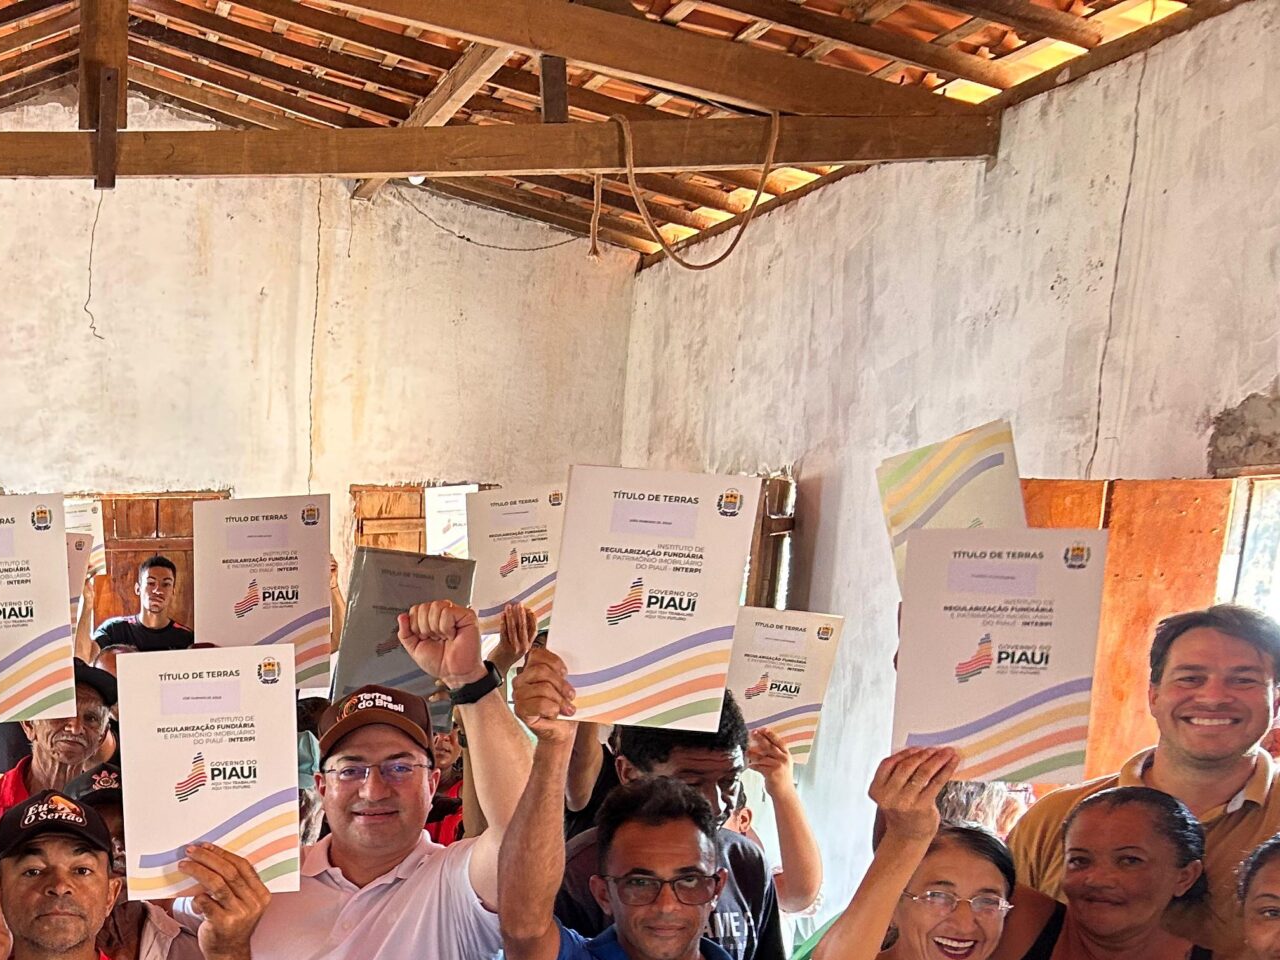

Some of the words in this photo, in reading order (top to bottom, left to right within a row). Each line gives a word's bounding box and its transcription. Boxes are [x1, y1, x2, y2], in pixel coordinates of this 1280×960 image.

[613, 490, 646, 500] TÍTULO
[662, 495, 699, 505] TERRAS
[600, 547, 661, 557] REGULARIZAÇÃO
[663, 552, 704, 560] FUNDIÁRIA
[953, 549, 987, 558] TÍTULO
[262, 589, 299, 602] PIAUÍ
[648, 589, 685, 597] GOVERNO
[646, 596, 697, 612] PIAUÍ
[996, 651, 1050, 665] PIAUÍ
[159, 672, 190, 681] TÍTULO
[206, 670, 240, 678] TERRAS
[358, 693, 392, 702] Terras
[358, 700, 373, 709] do
[375, 699, 404, 712] Brasil
[157, 724, 215, 733] REGULARIZAÇÃO
[217, 722, 255, 730] FUNDIÁRIA
[210, 765, 257, 781] PIAUÍ
[26, 803, 49, 817] Eu
[24, 815, 35, 825] O
